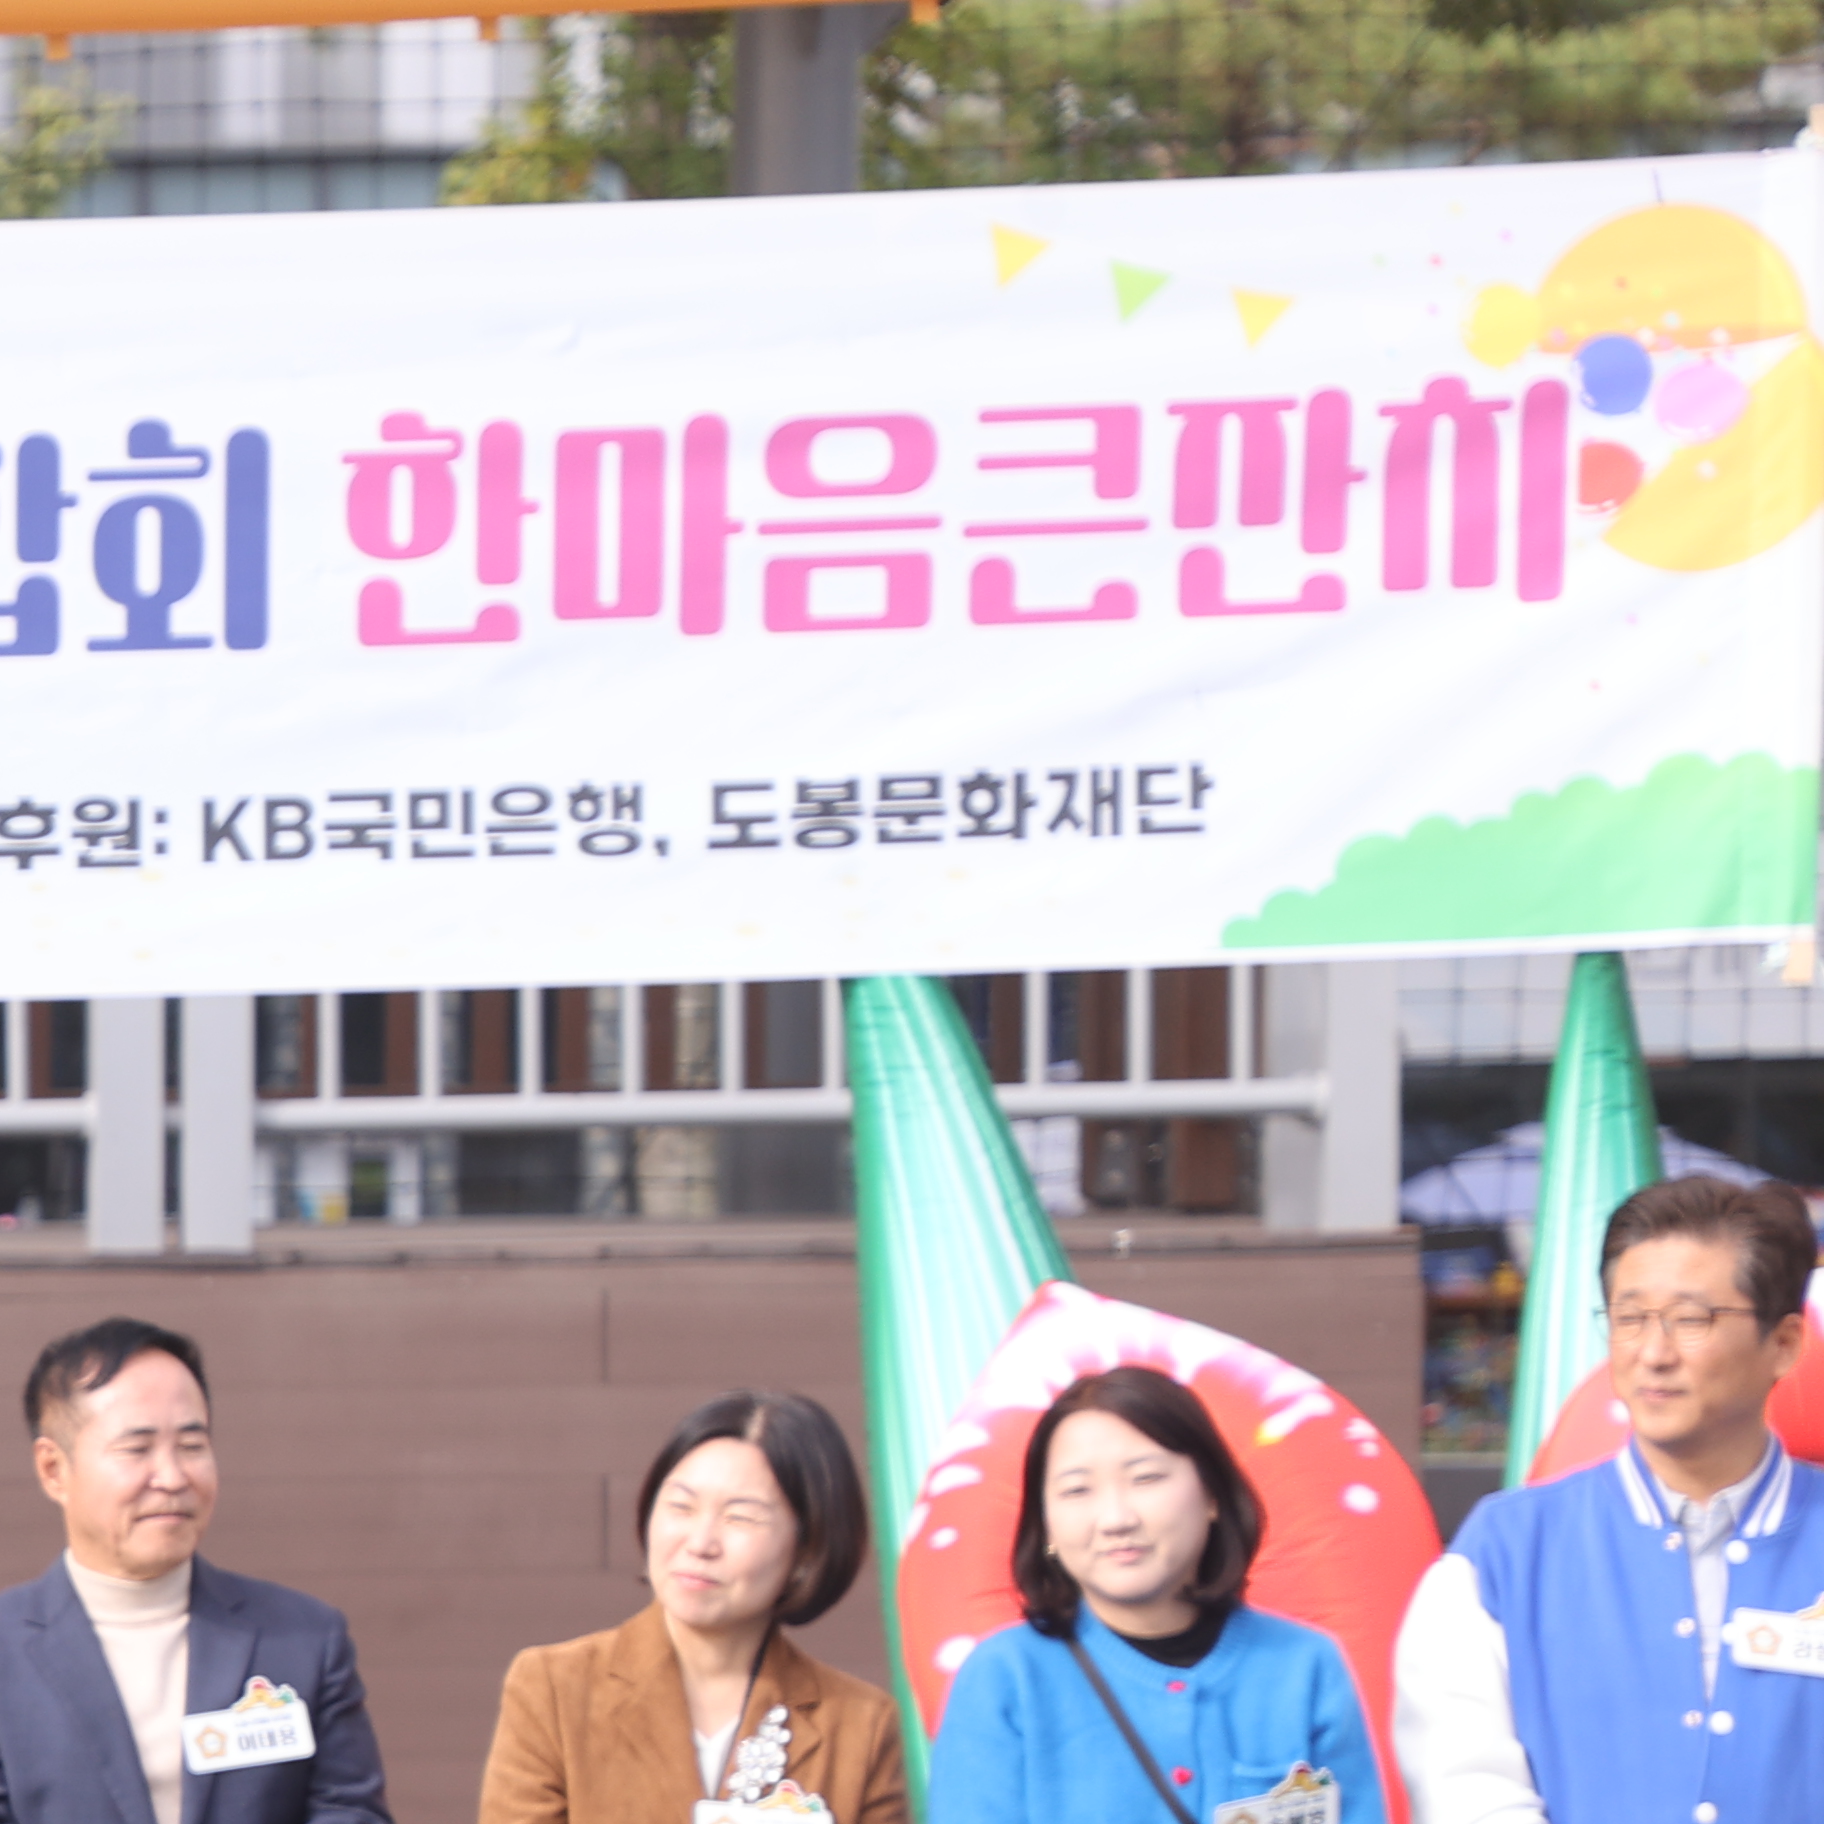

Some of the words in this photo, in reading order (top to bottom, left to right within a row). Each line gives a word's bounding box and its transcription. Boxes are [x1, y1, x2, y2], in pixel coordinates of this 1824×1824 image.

[341, 375, 1571, 648] 한마음큰잔치
[202, 784, 669, 863] KB국민은행,
[707, 765, 1213, 850] 도봉문화재단
